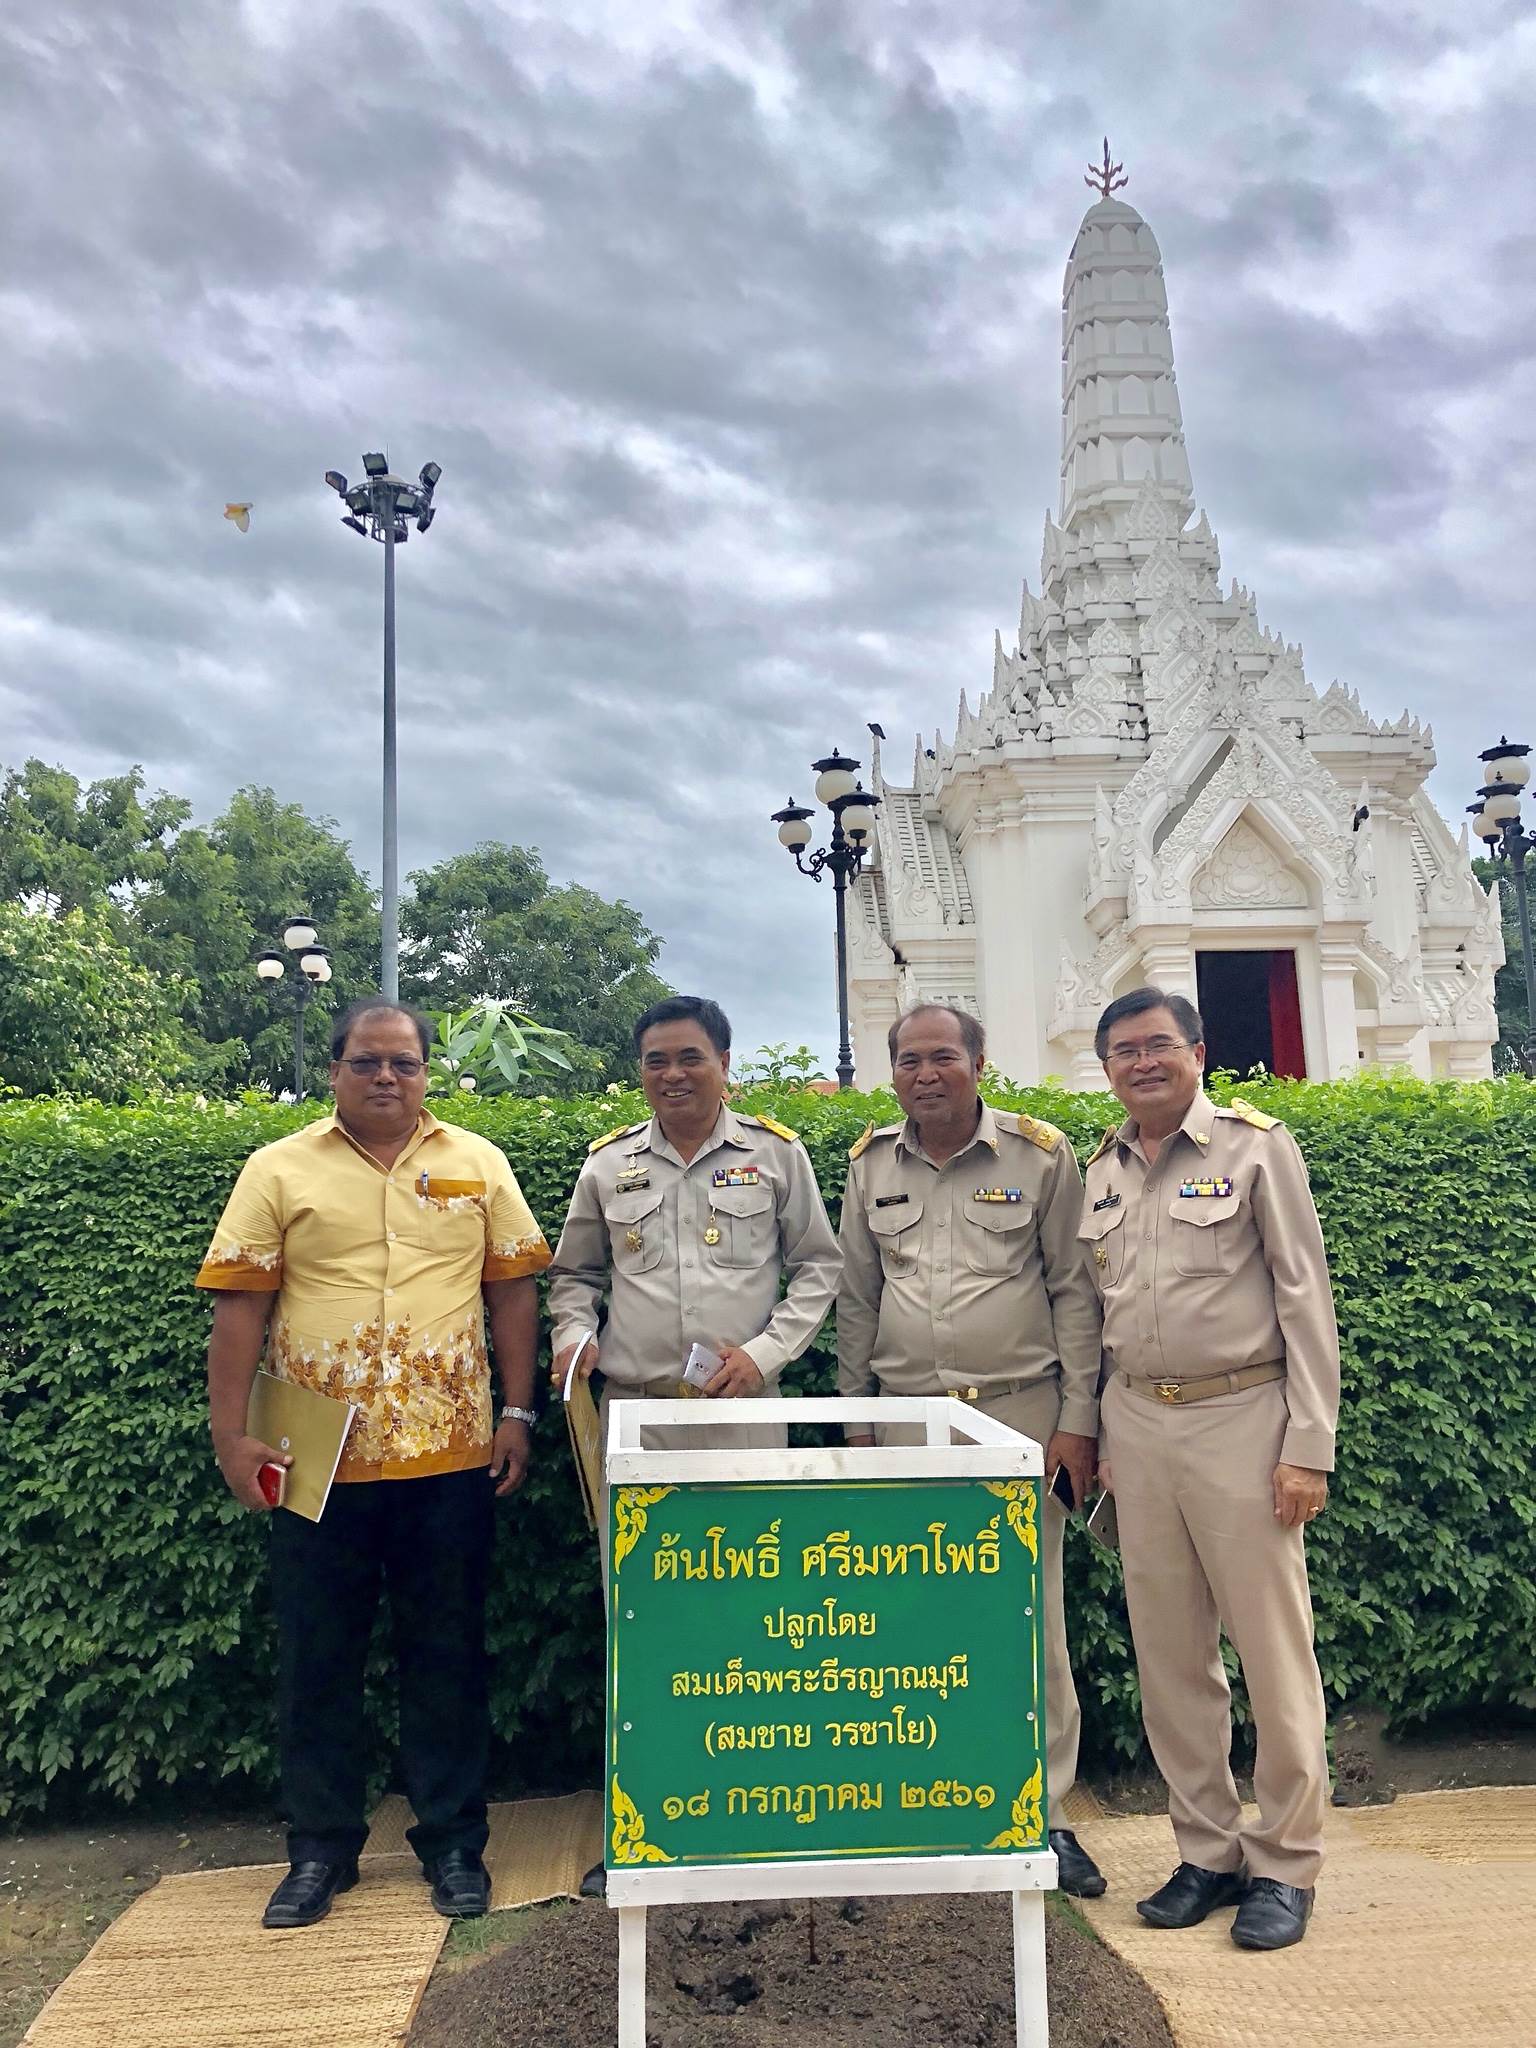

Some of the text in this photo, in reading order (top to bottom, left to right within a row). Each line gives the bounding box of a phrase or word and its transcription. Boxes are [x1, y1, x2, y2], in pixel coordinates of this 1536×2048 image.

[653, 1514, 1001, 1580] ต้นโพธิ์ ศรีมหาโพธิ์
[763, 1598, 877, 1649] ปลูกโดย
[671, 1654, 969, 1699] สมเด็จพระธีรญาณมุนี
[704, 1704, 938, 1757] (สมชาย วรชาโย)
[662, 1779, 997, 1824] ๑๘ กรกฎาคม ๒๕๖๑
